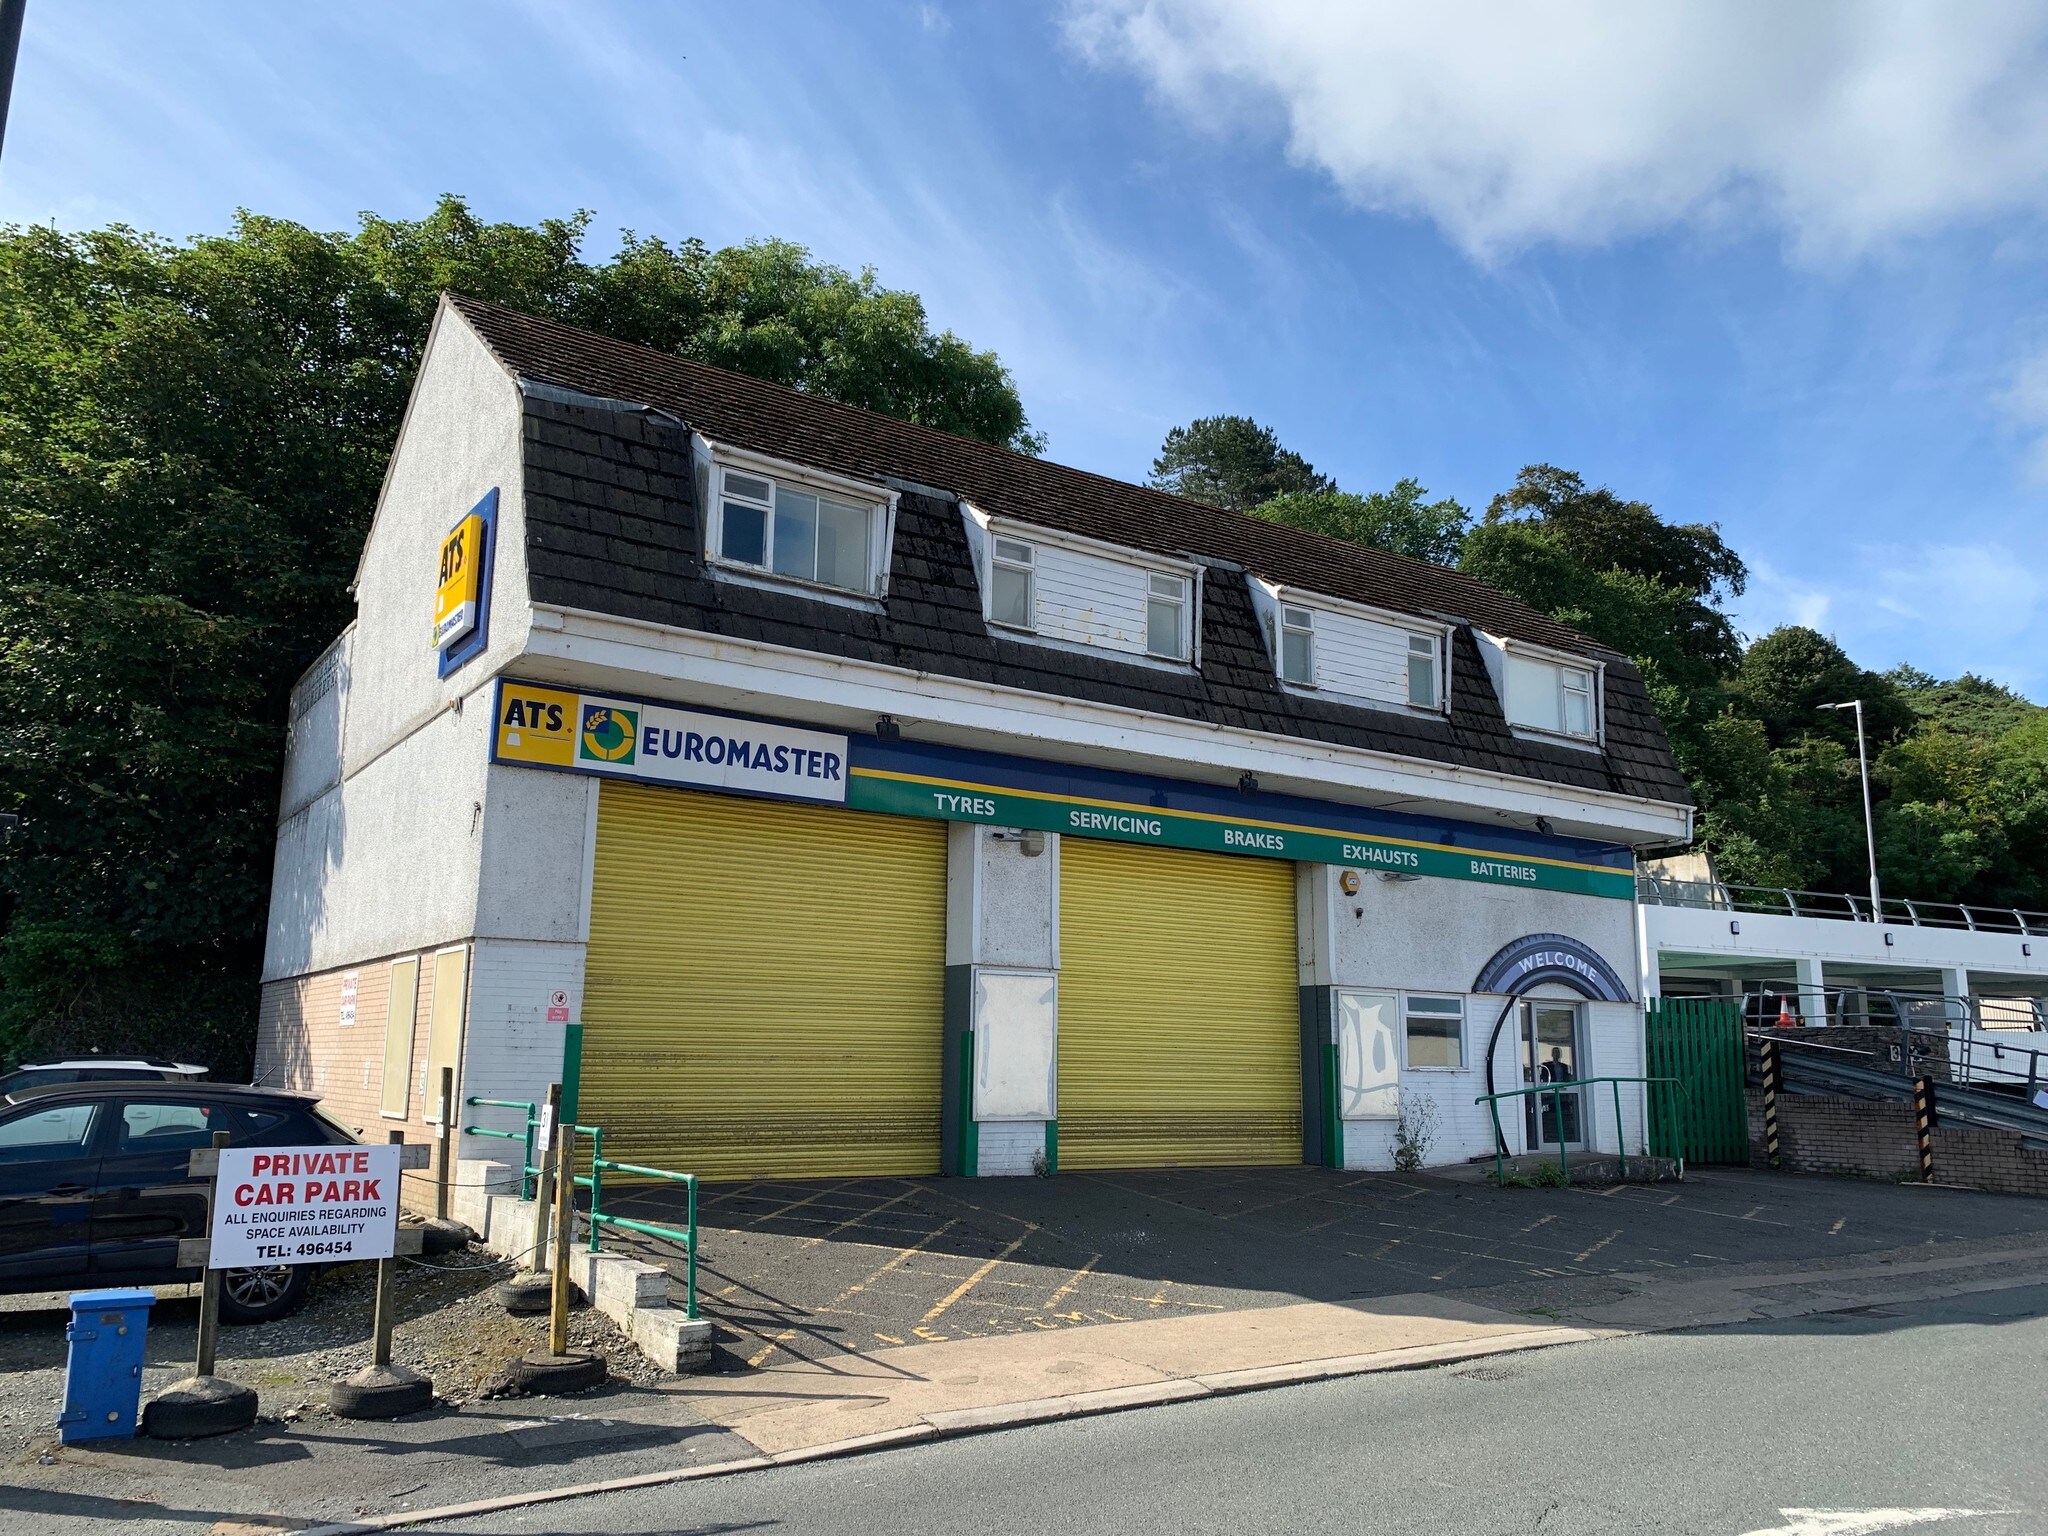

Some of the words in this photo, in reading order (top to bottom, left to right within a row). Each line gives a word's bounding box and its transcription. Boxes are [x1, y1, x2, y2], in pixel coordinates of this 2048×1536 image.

[439, 529, 464, 588] ATS
[504, 698, 563, 732] ATS
[642, 726, 841, 781] EUROMASTER
[933, 793, 995, 817] TYRES
[1069, 810, 1161, 836] SERVICING
[1224, 829, 1284, 851] BRAKES
[1343, 844, 1419, 868] EXHAUSTS
[1470, 860, 1537, 882] BATTERIES
[1518, 951, 1598, 983] WELCOME
[252, 1151, 369, 1177] PRIVATE
[234, 1182, 295, 1207] CAR
[304, 1179, 382, 1204] PARK
[225, 1213, 248, 1225] ALL
[252, 1210, 316, 1224] ENQUIRIES
[318, 1207, 387, 1220] REGARDING
[246, 1227, 285, 1240] SPACE
[288, 1223, 366, 1237] AVAILABILITY
[256, 1245, 292, 1259] TEL:
[296, 1241, 353, 1257] 496454
